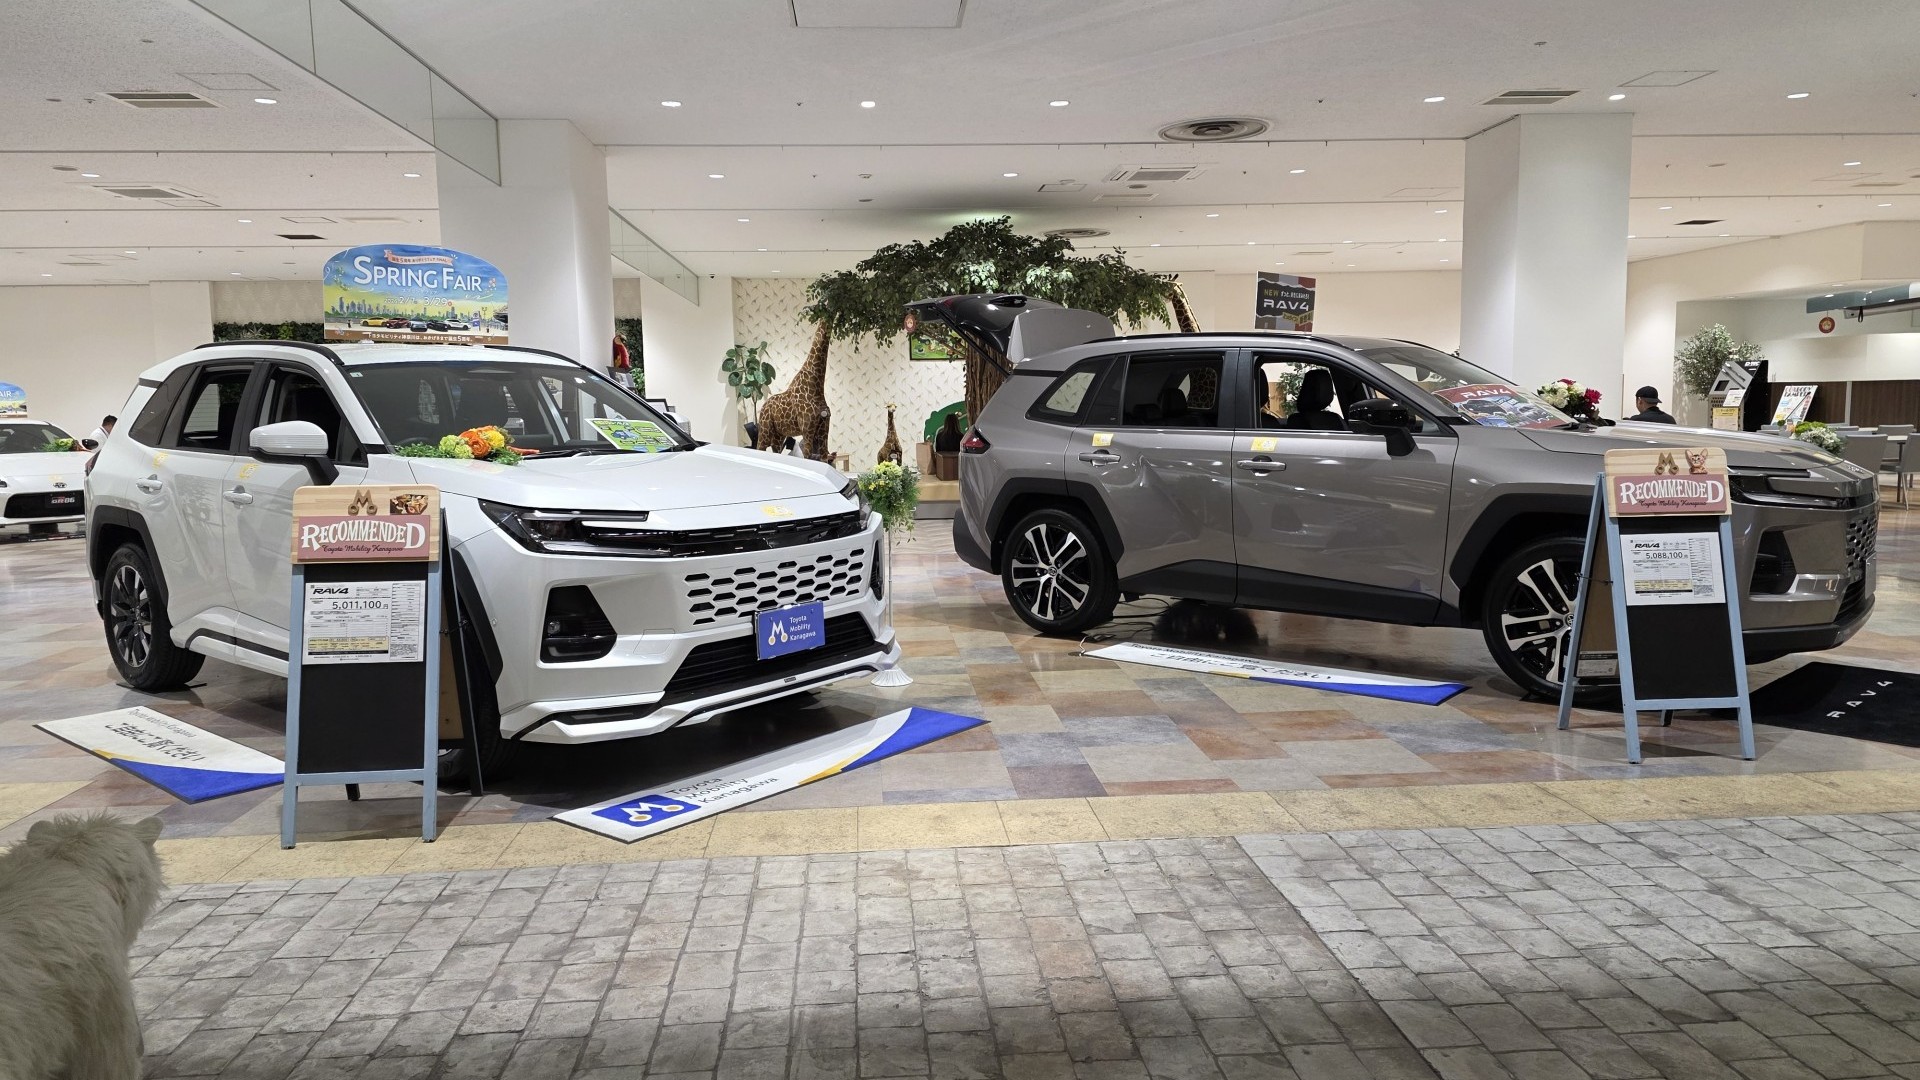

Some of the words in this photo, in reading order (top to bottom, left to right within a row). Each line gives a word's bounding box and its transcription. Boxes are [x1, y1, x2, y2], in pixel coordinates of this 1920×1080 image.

[1263, 288, 1279, 297] NEW
[1263, 298, 1309, 311] RAV4
[1620, 479, 1725, 506] RECOMMENDED
[301, 519, 426, 551] RECOMMENDED
[344, 544, 371, 554] Mobility
[312, 587, 349, 595] RAV4
[789, 615, 807, 624] Toyota
[789, 623, 811, 633] Mobility
[789, 631, 816, 641] Kanagawa
[1826, 680, 1893, 718] RAV4
[665, 777, 723, 795] Toyota
[679, 778, 749, 800] Mobility
[697, 777, 778, 804] Kanagawa
